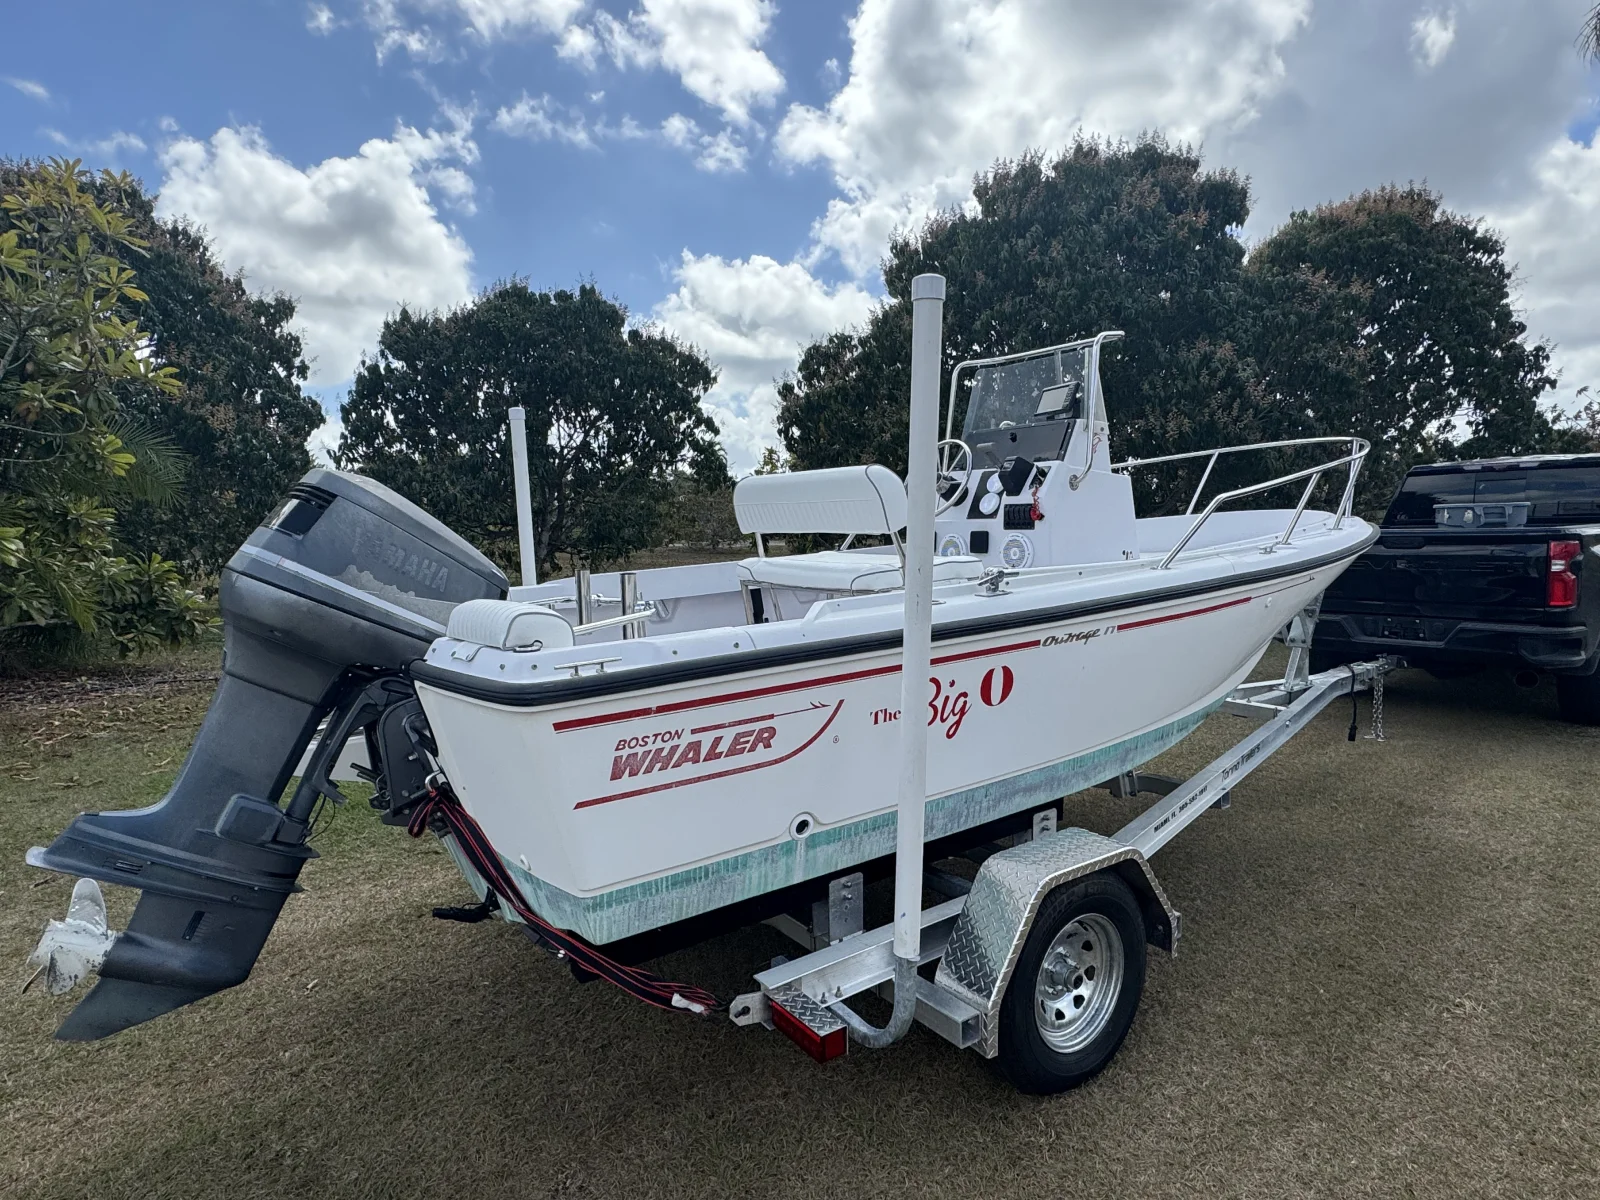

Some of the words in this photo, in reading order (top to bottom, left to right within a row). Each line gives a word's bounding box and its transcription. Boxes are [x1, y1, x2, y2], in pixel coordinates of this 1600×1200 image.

[1042, 629, 1101, 646] Outrage
[870, 708, 902, 725] The
[980, 665, 1014, 707] O
[610, 726, 777, 781] WHALER
[615, 728, 685, 751] BOSTON
